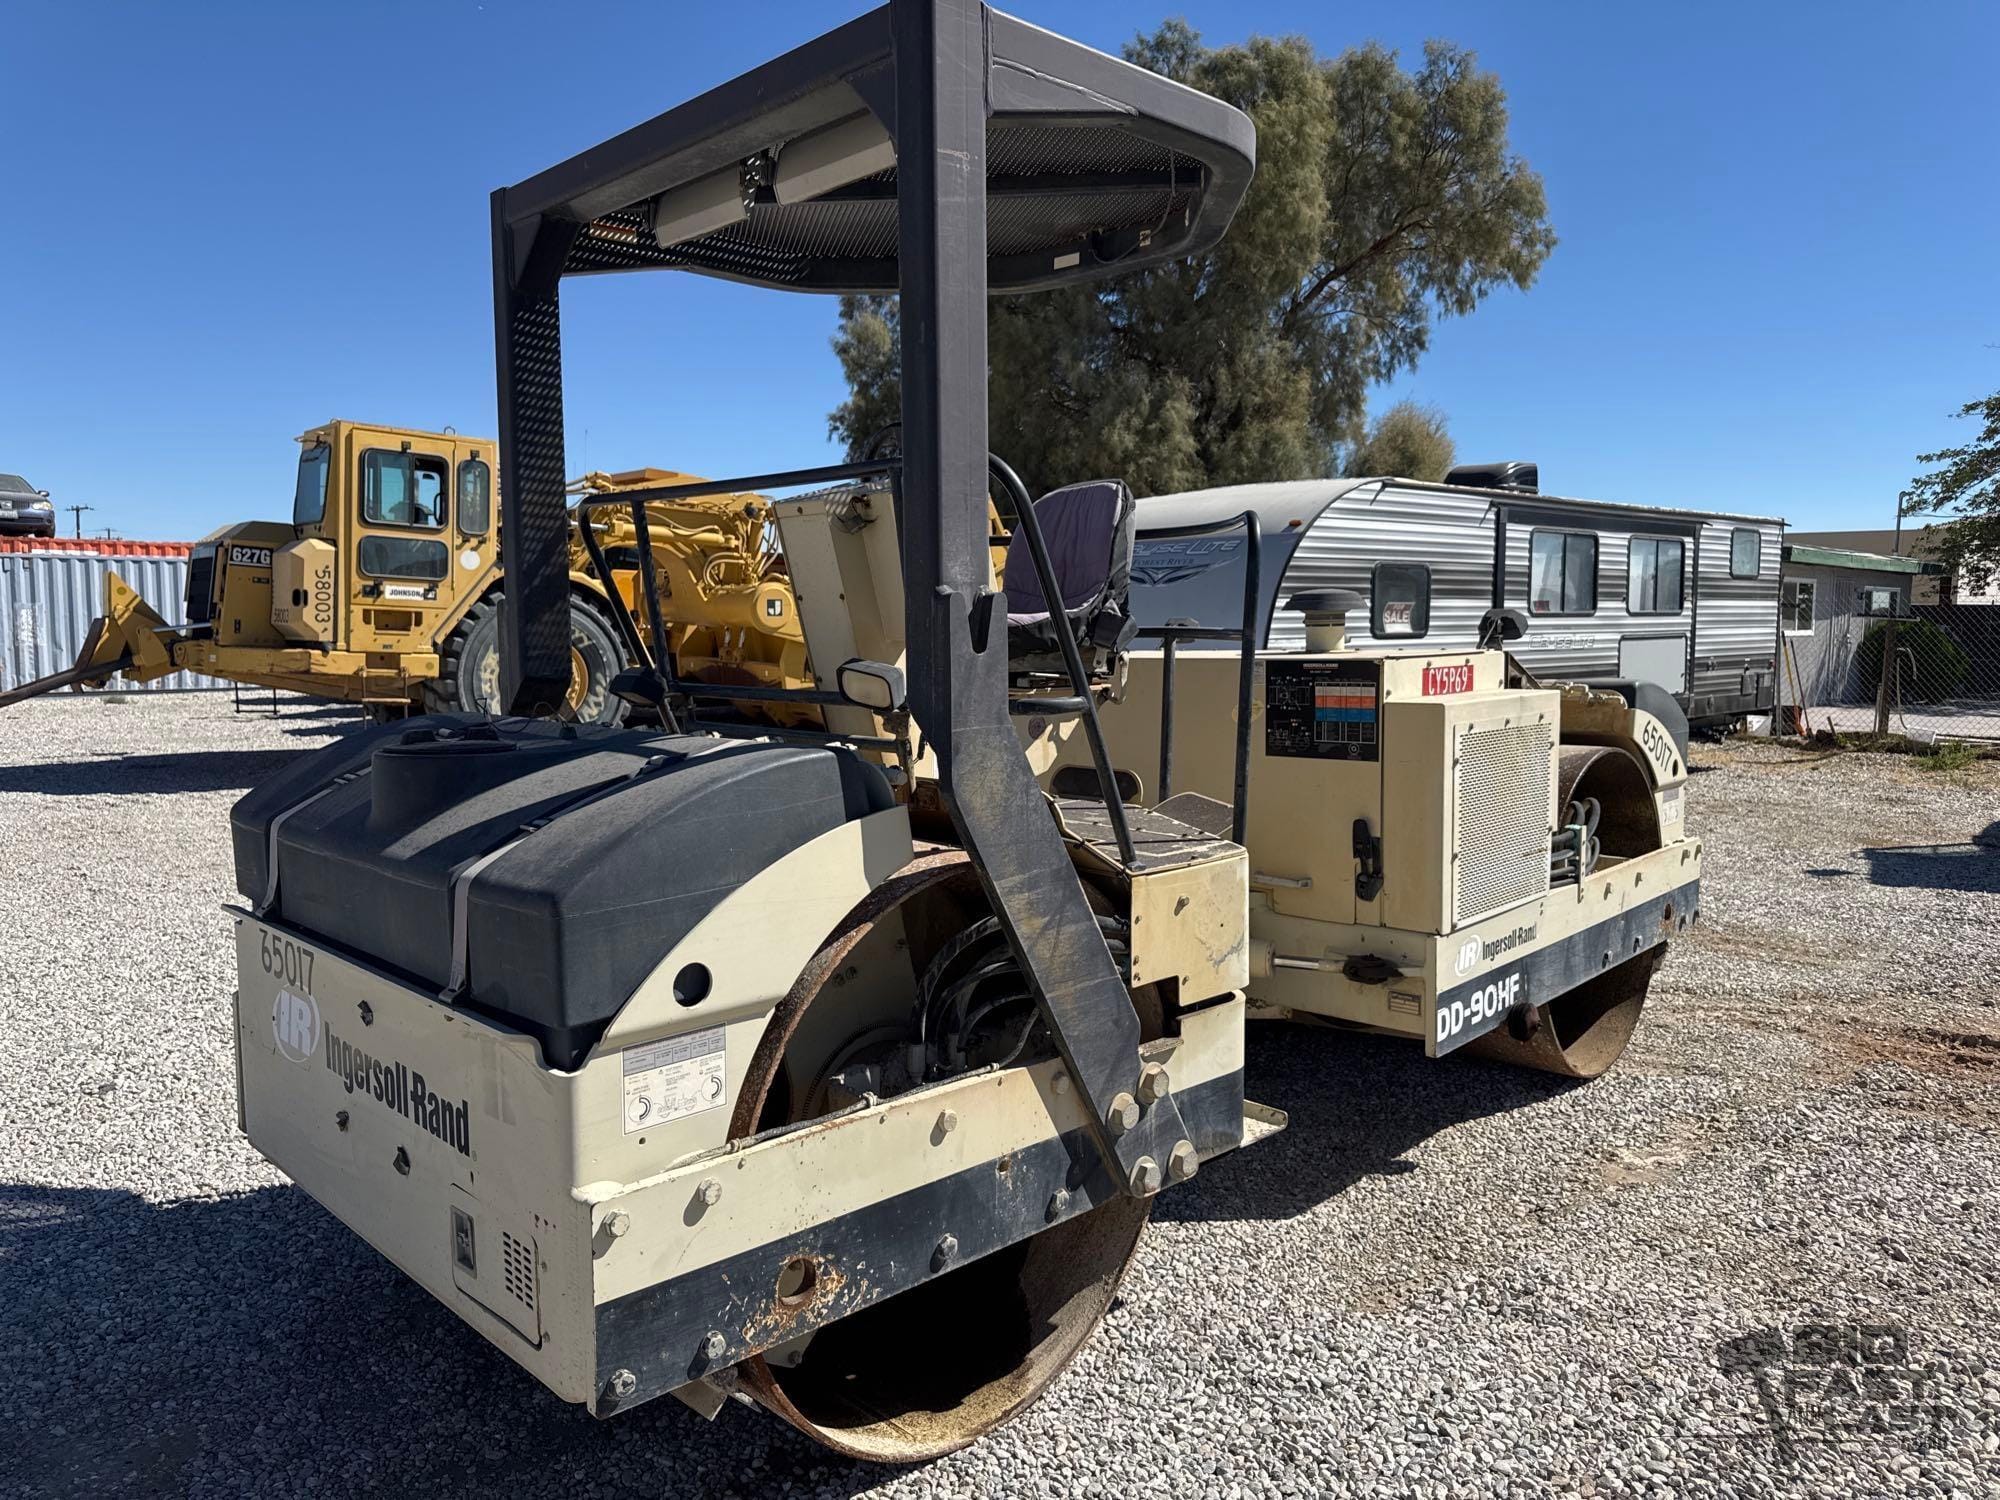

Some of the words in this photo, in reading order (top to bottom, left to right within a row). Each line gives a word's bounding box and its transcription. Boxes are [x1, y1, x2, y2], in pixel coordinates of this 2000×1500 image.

[231, 548, 271, 564] 627G
[314, 567, 332, 624] 58003
[389, 589, 421, 597] JOHNSON
[1384, 610, 1410, 624] SALE
[1428, 666, 1468, 695] CY5P69
[1642, 720, 1672, 773] 65017
[258, 927, 315, 996] 65017
[278, 988, 312, 1058] IR
[1436, 972, 1521, 1043] DD-90HF
